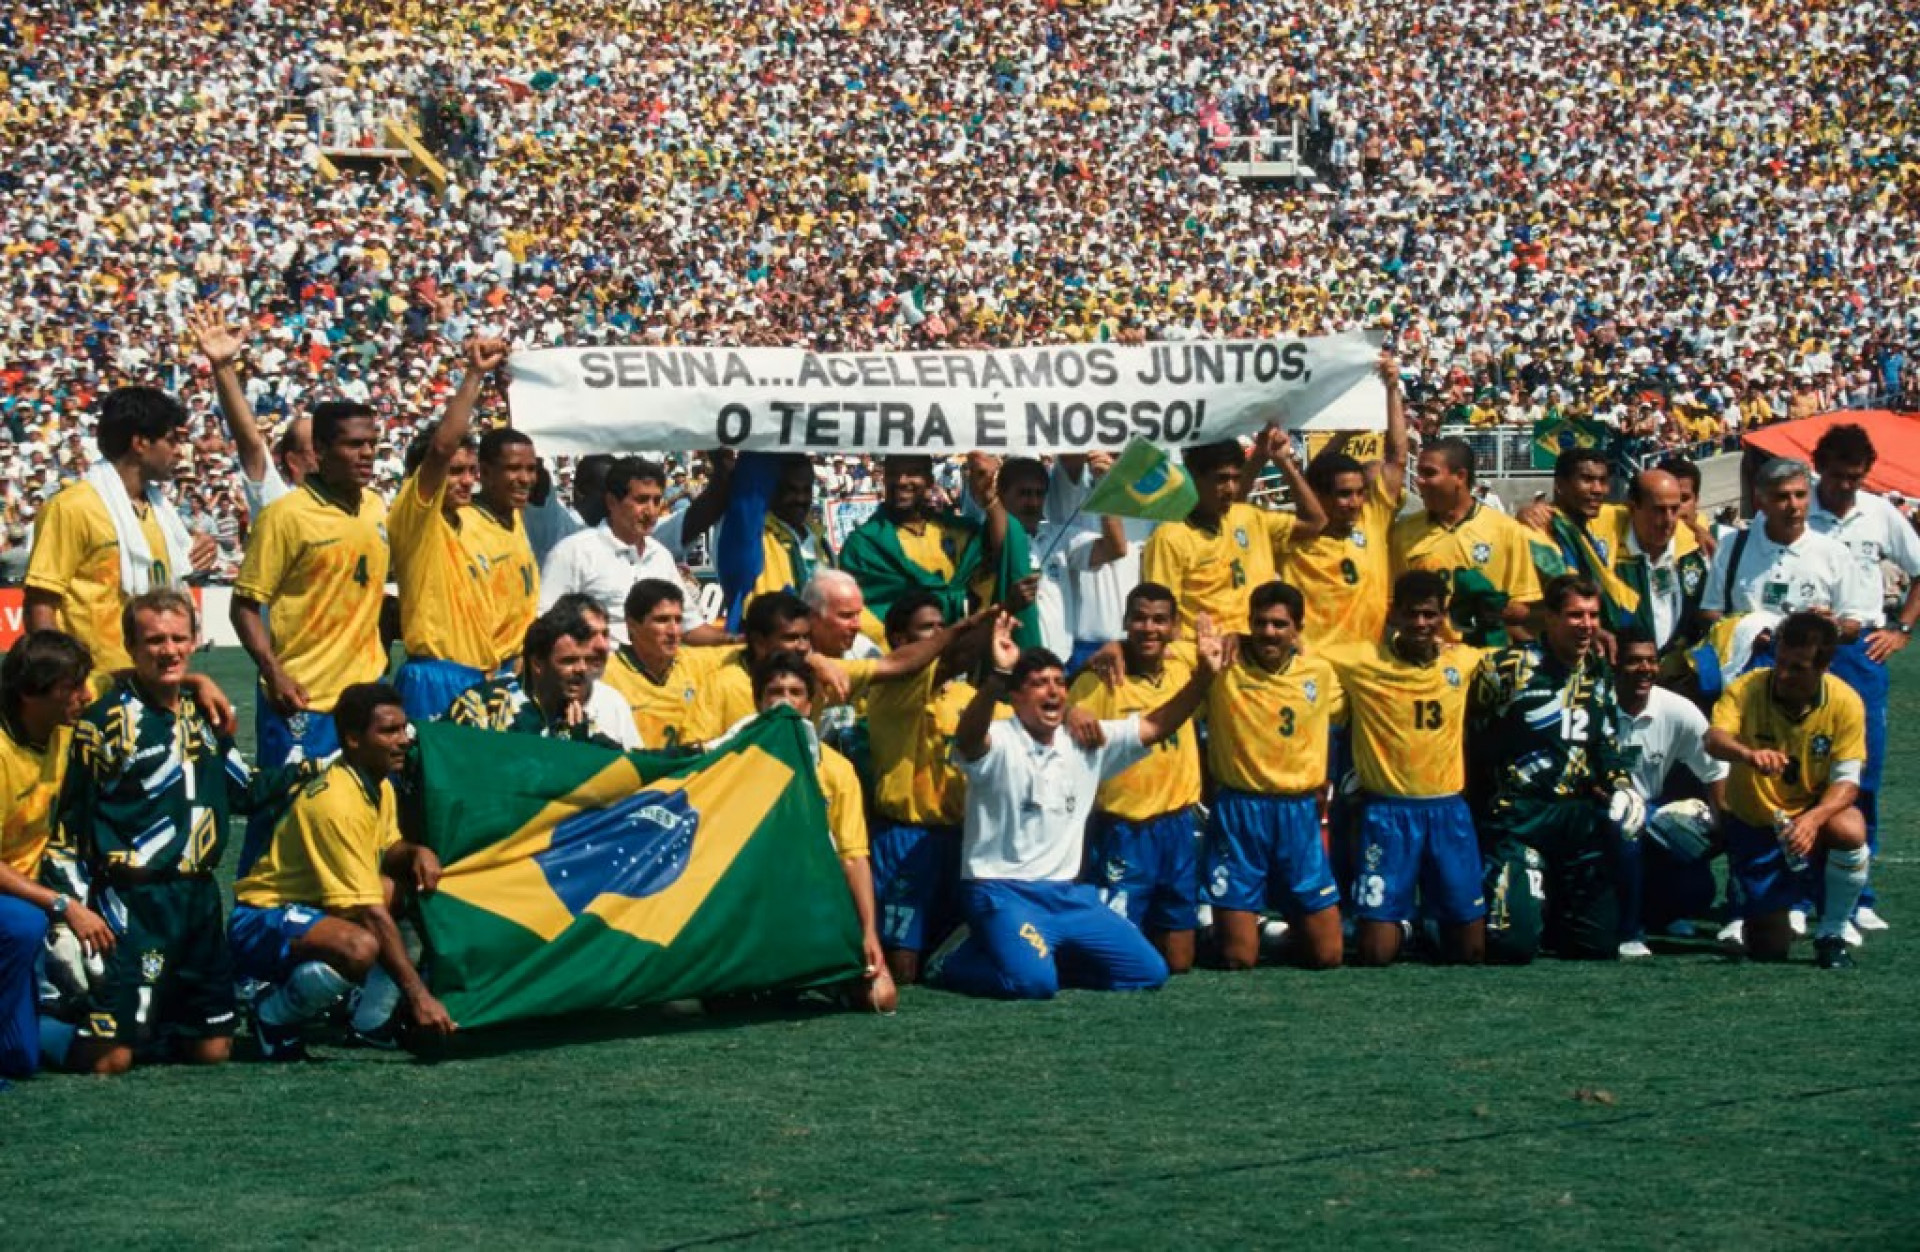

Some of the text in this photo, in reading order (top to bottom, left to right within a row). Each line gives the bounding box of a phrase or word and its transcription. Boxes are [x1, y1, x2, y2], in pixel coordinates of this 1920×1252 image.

[1137, 343, 1312, 384] JUNTOS,
[717, 392, 1206, 446] O TETRA É NOSSO!
[353, 555, 370, 588] 4
[1340, 558, 1358, 585] 9
[1279, 706, 1296, 737] 3
[1413, 700, 1443, 730] 13
[1561, 707, 1589, 741] 12
[182, 760, 196, 801] 1
[1359, 874, 1385, 906] 13
[885, 904, 915, 939] 17
